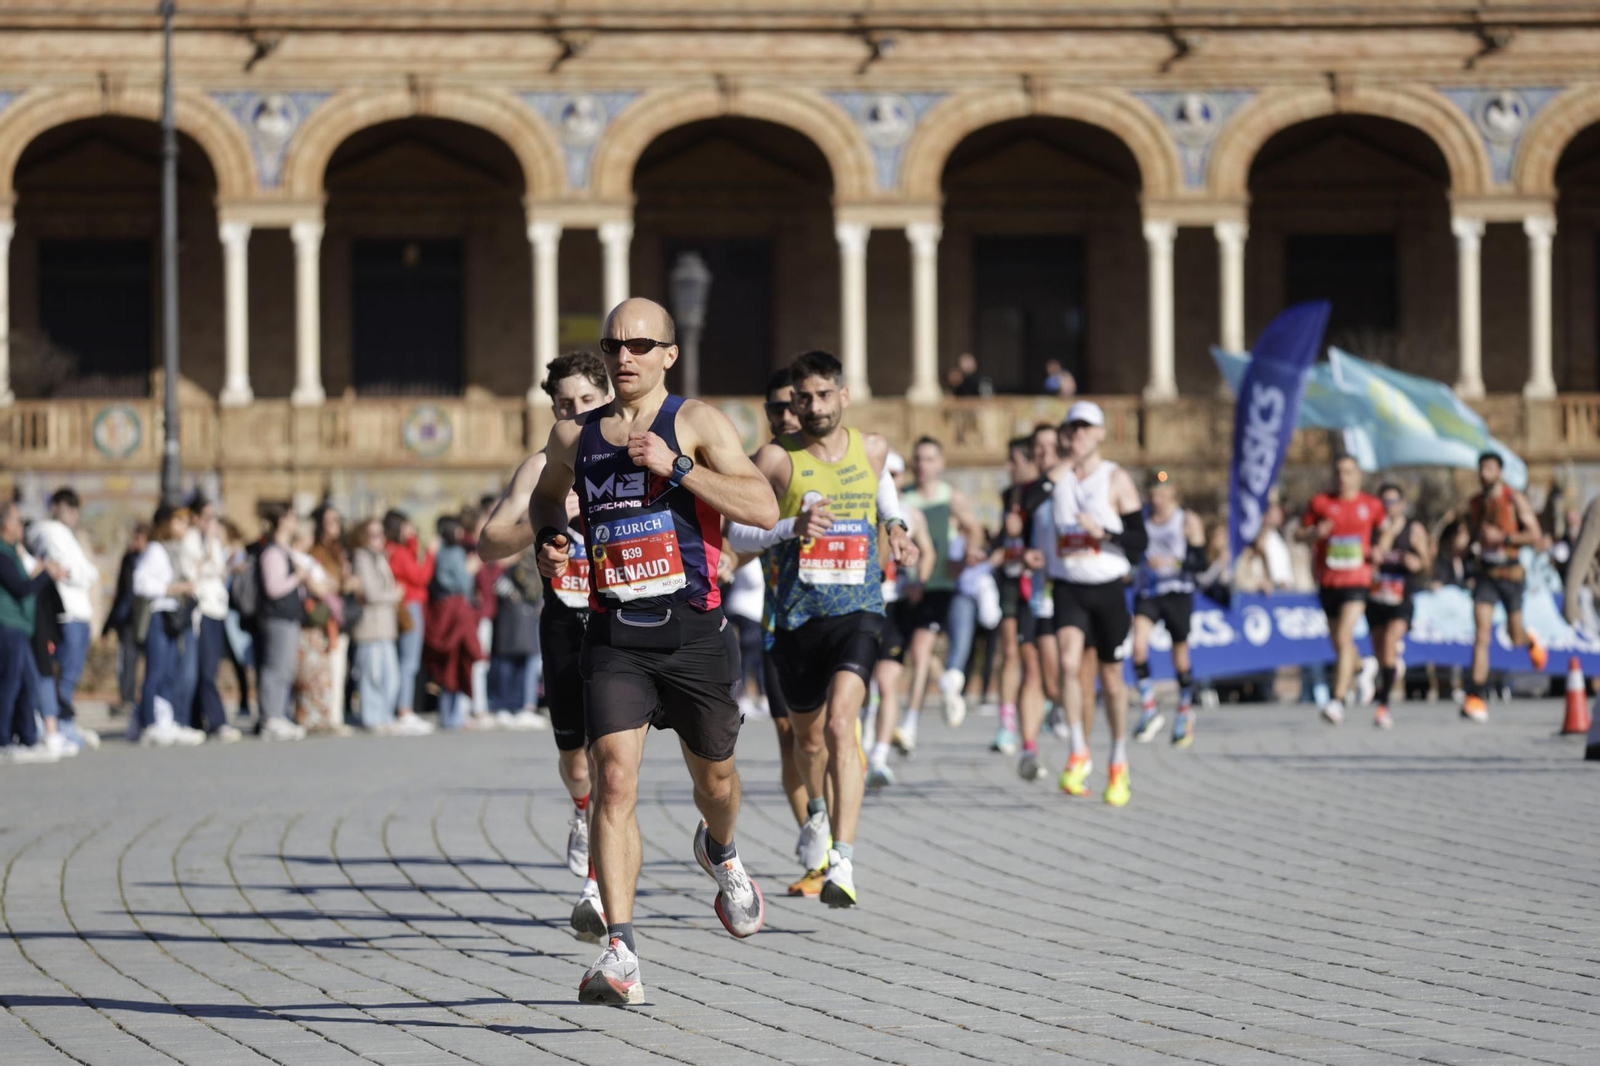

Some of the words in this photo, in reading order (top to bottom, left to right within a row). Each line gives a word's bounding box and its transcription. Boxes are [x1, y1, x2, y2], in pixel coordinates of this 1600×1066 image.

[589, 500, 642, 514] COACHING
[614, 518, 663, 537] ZURICH
[827, 523, 862, 533] URICH
[622, 546, 643, 560] 939
[828, 541, 845, 552] 974
[799, 558, 836, 568] CARLOS
[837, 559, 844, 568] Y
[604, 558, 670, 585] RENAUD
[561, 575, 590, 592] SEV
